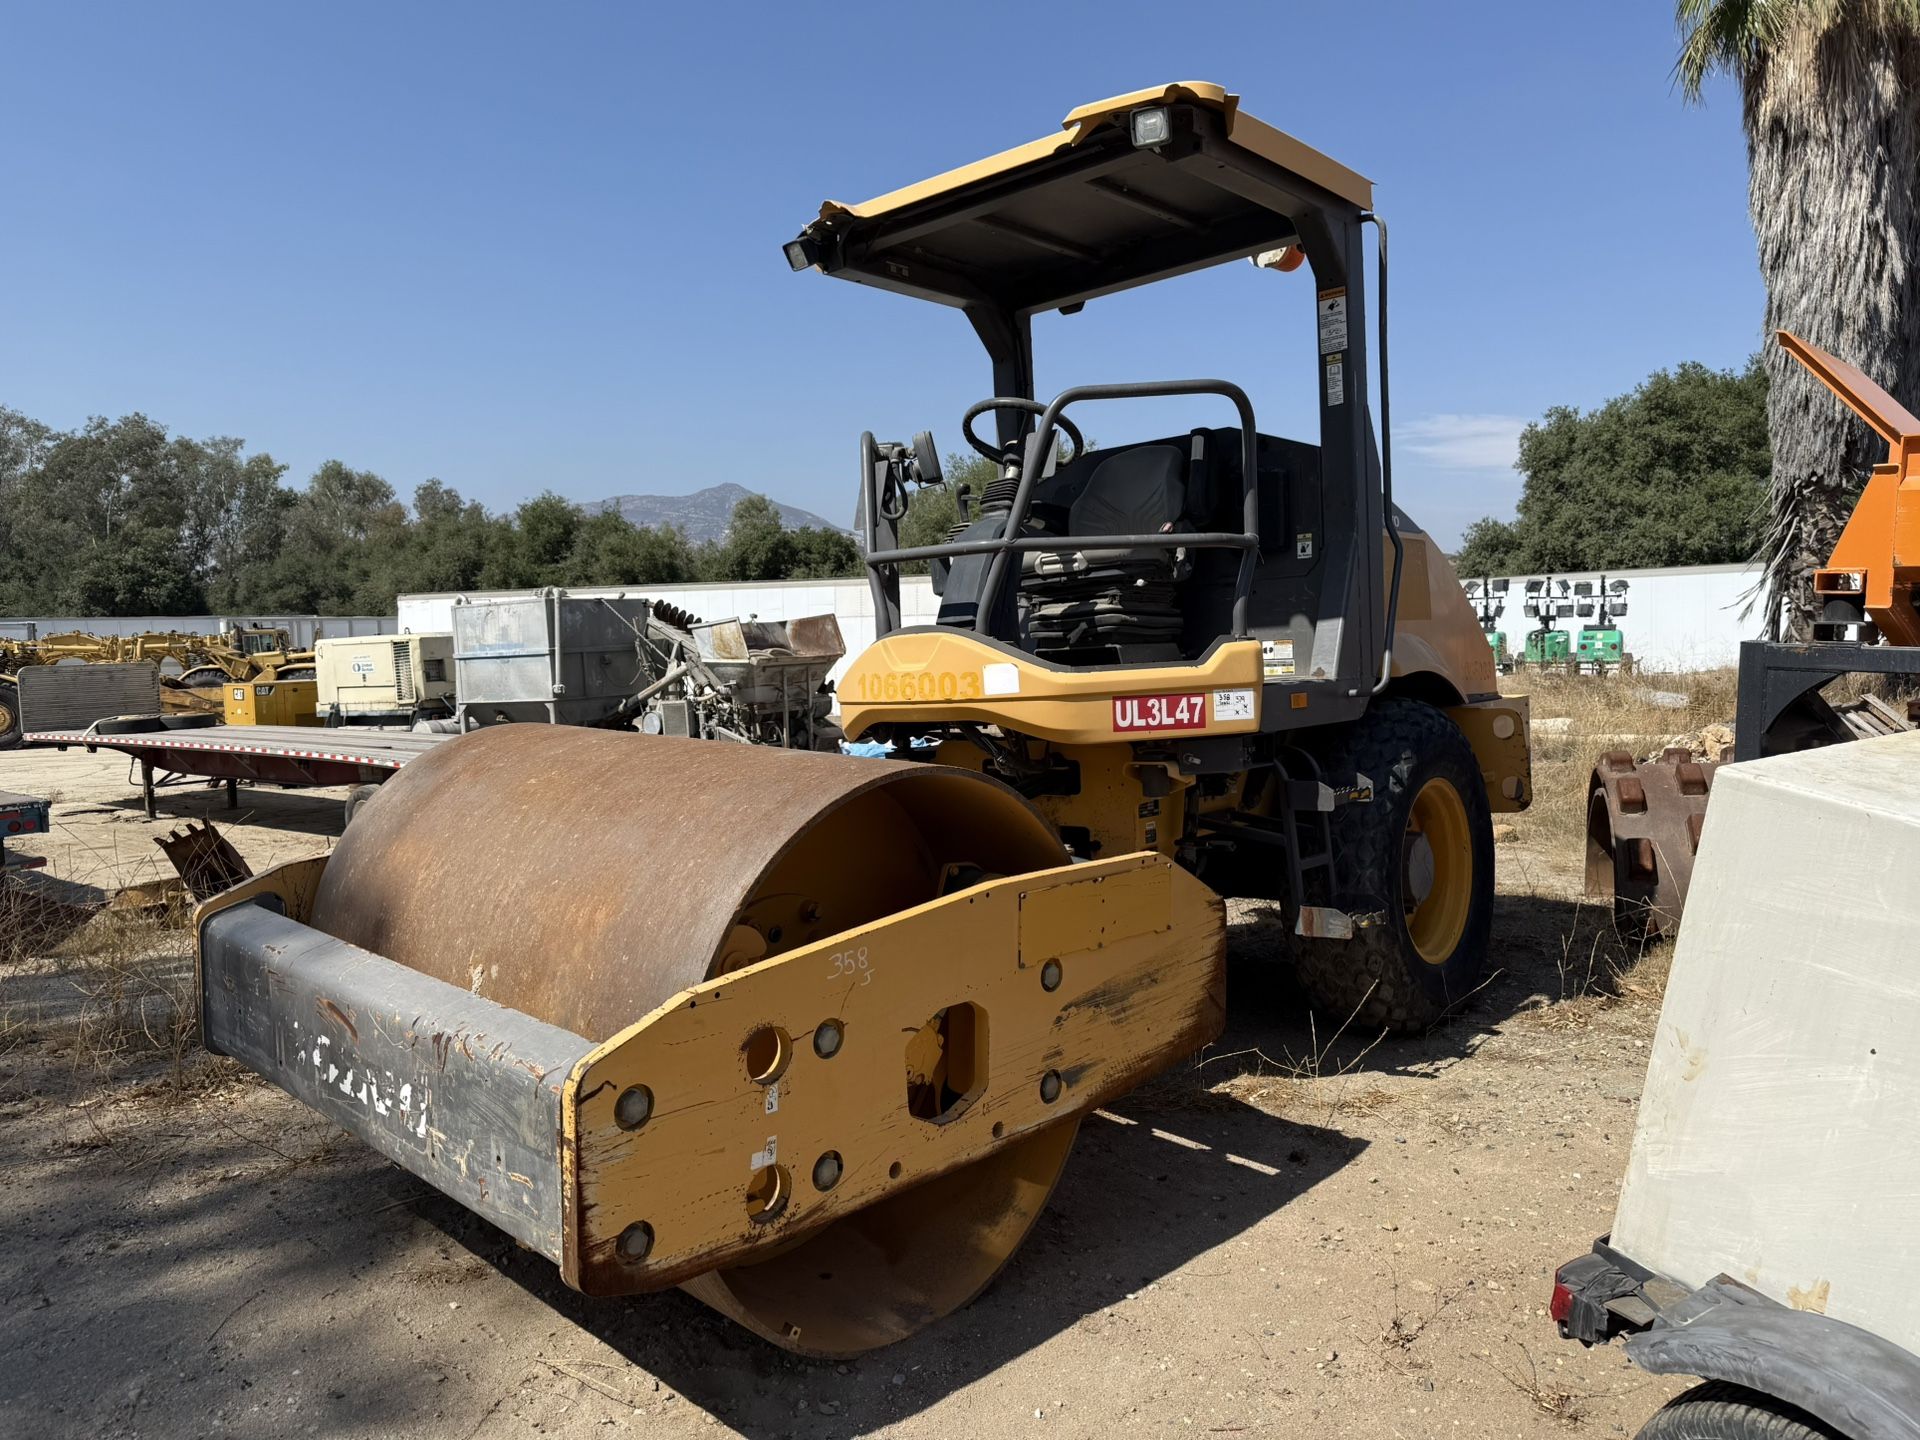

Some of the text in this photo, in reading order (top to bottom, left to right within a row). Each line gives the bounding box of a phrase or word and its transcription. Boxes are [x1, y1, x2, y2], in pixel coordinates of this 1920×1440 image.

[256, 686, 270, 696] CAT
[858, 671, 980, 700] 1066003
[1115, 696, 1204, 728] UL3L47
[827, 946, 868, 980] 358
